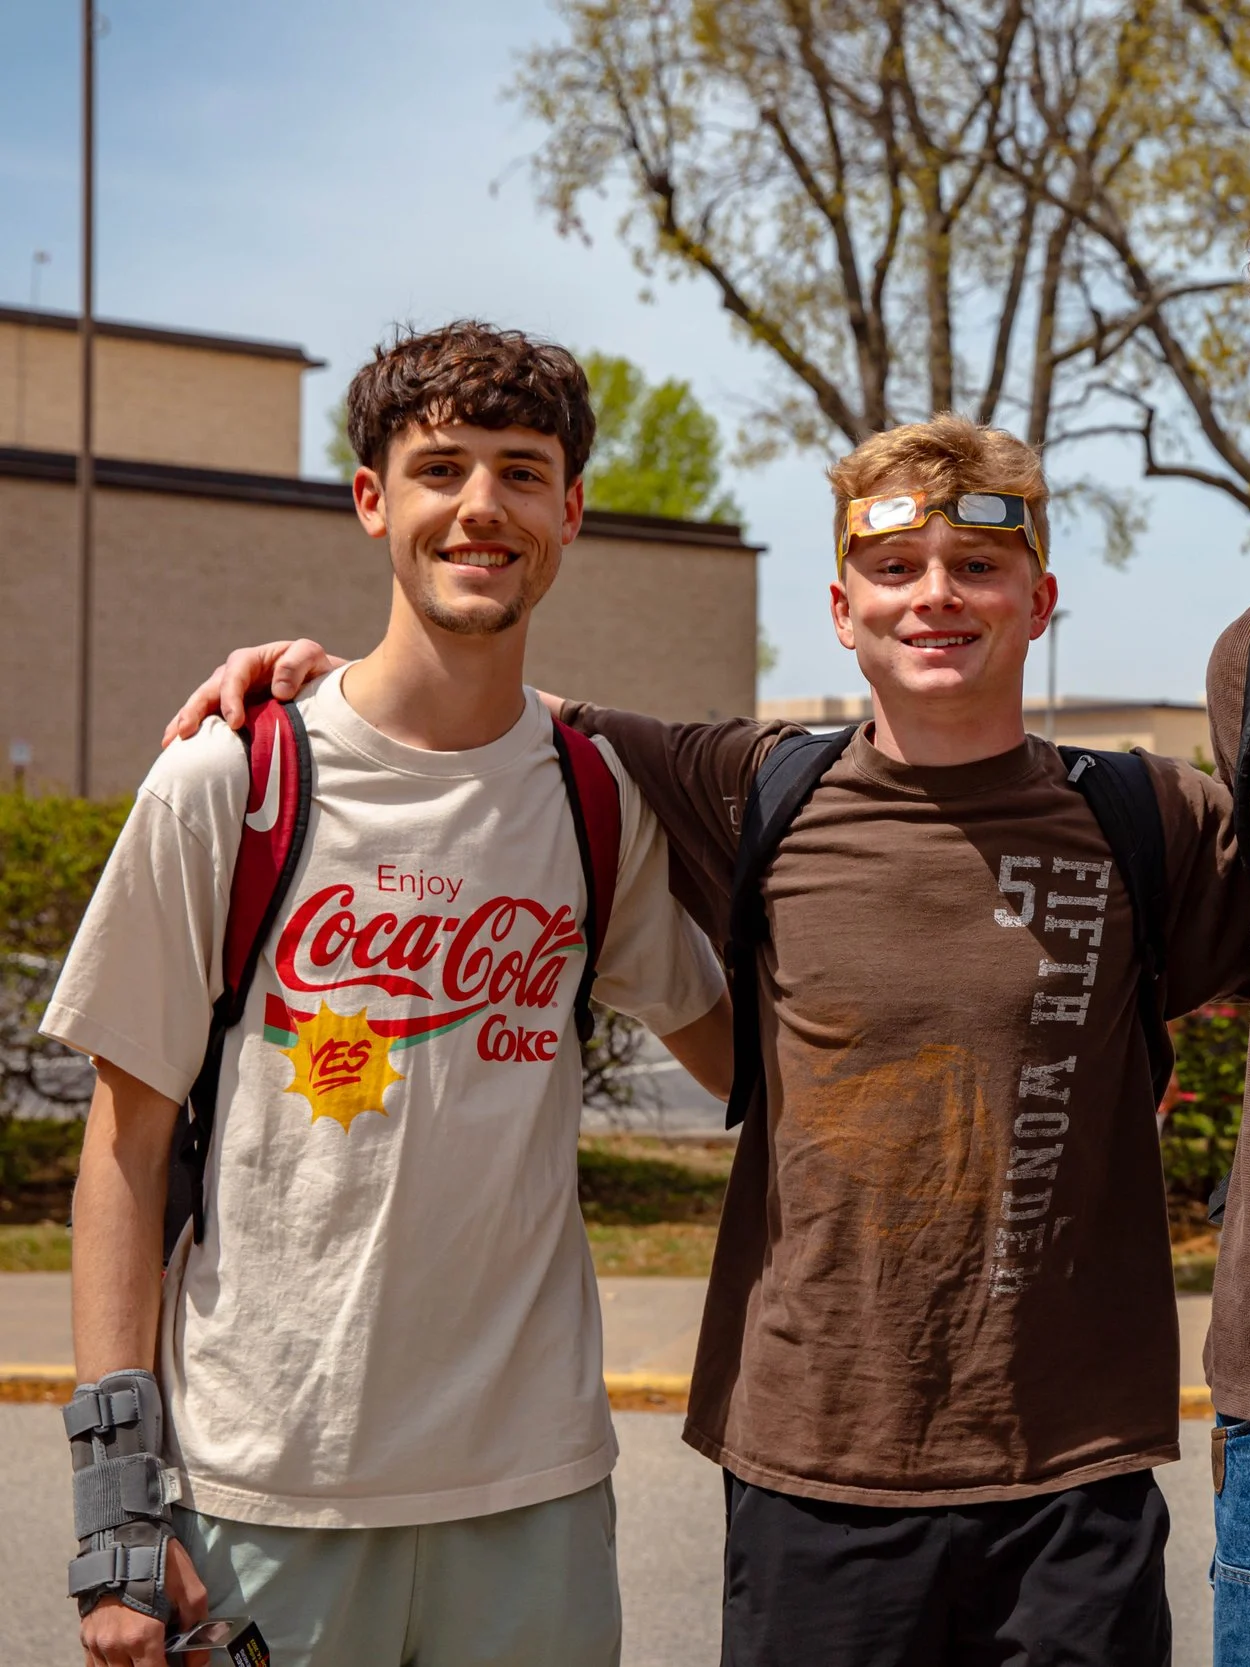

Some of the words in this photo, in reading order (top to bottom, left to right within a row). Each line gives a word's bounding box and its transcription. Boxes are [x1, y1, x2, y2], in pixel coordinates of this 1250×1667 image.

[377, 864, 464, 902] Enjoy
[994, 855, 1041, 929] 5
[275, 883, 575, 1009] Coca-Cola
[1029, 855, 1113, 1026] FIFTH
[309, 1038, 372, 1082] YES
[476, 1013, 558, 1064] Coke
